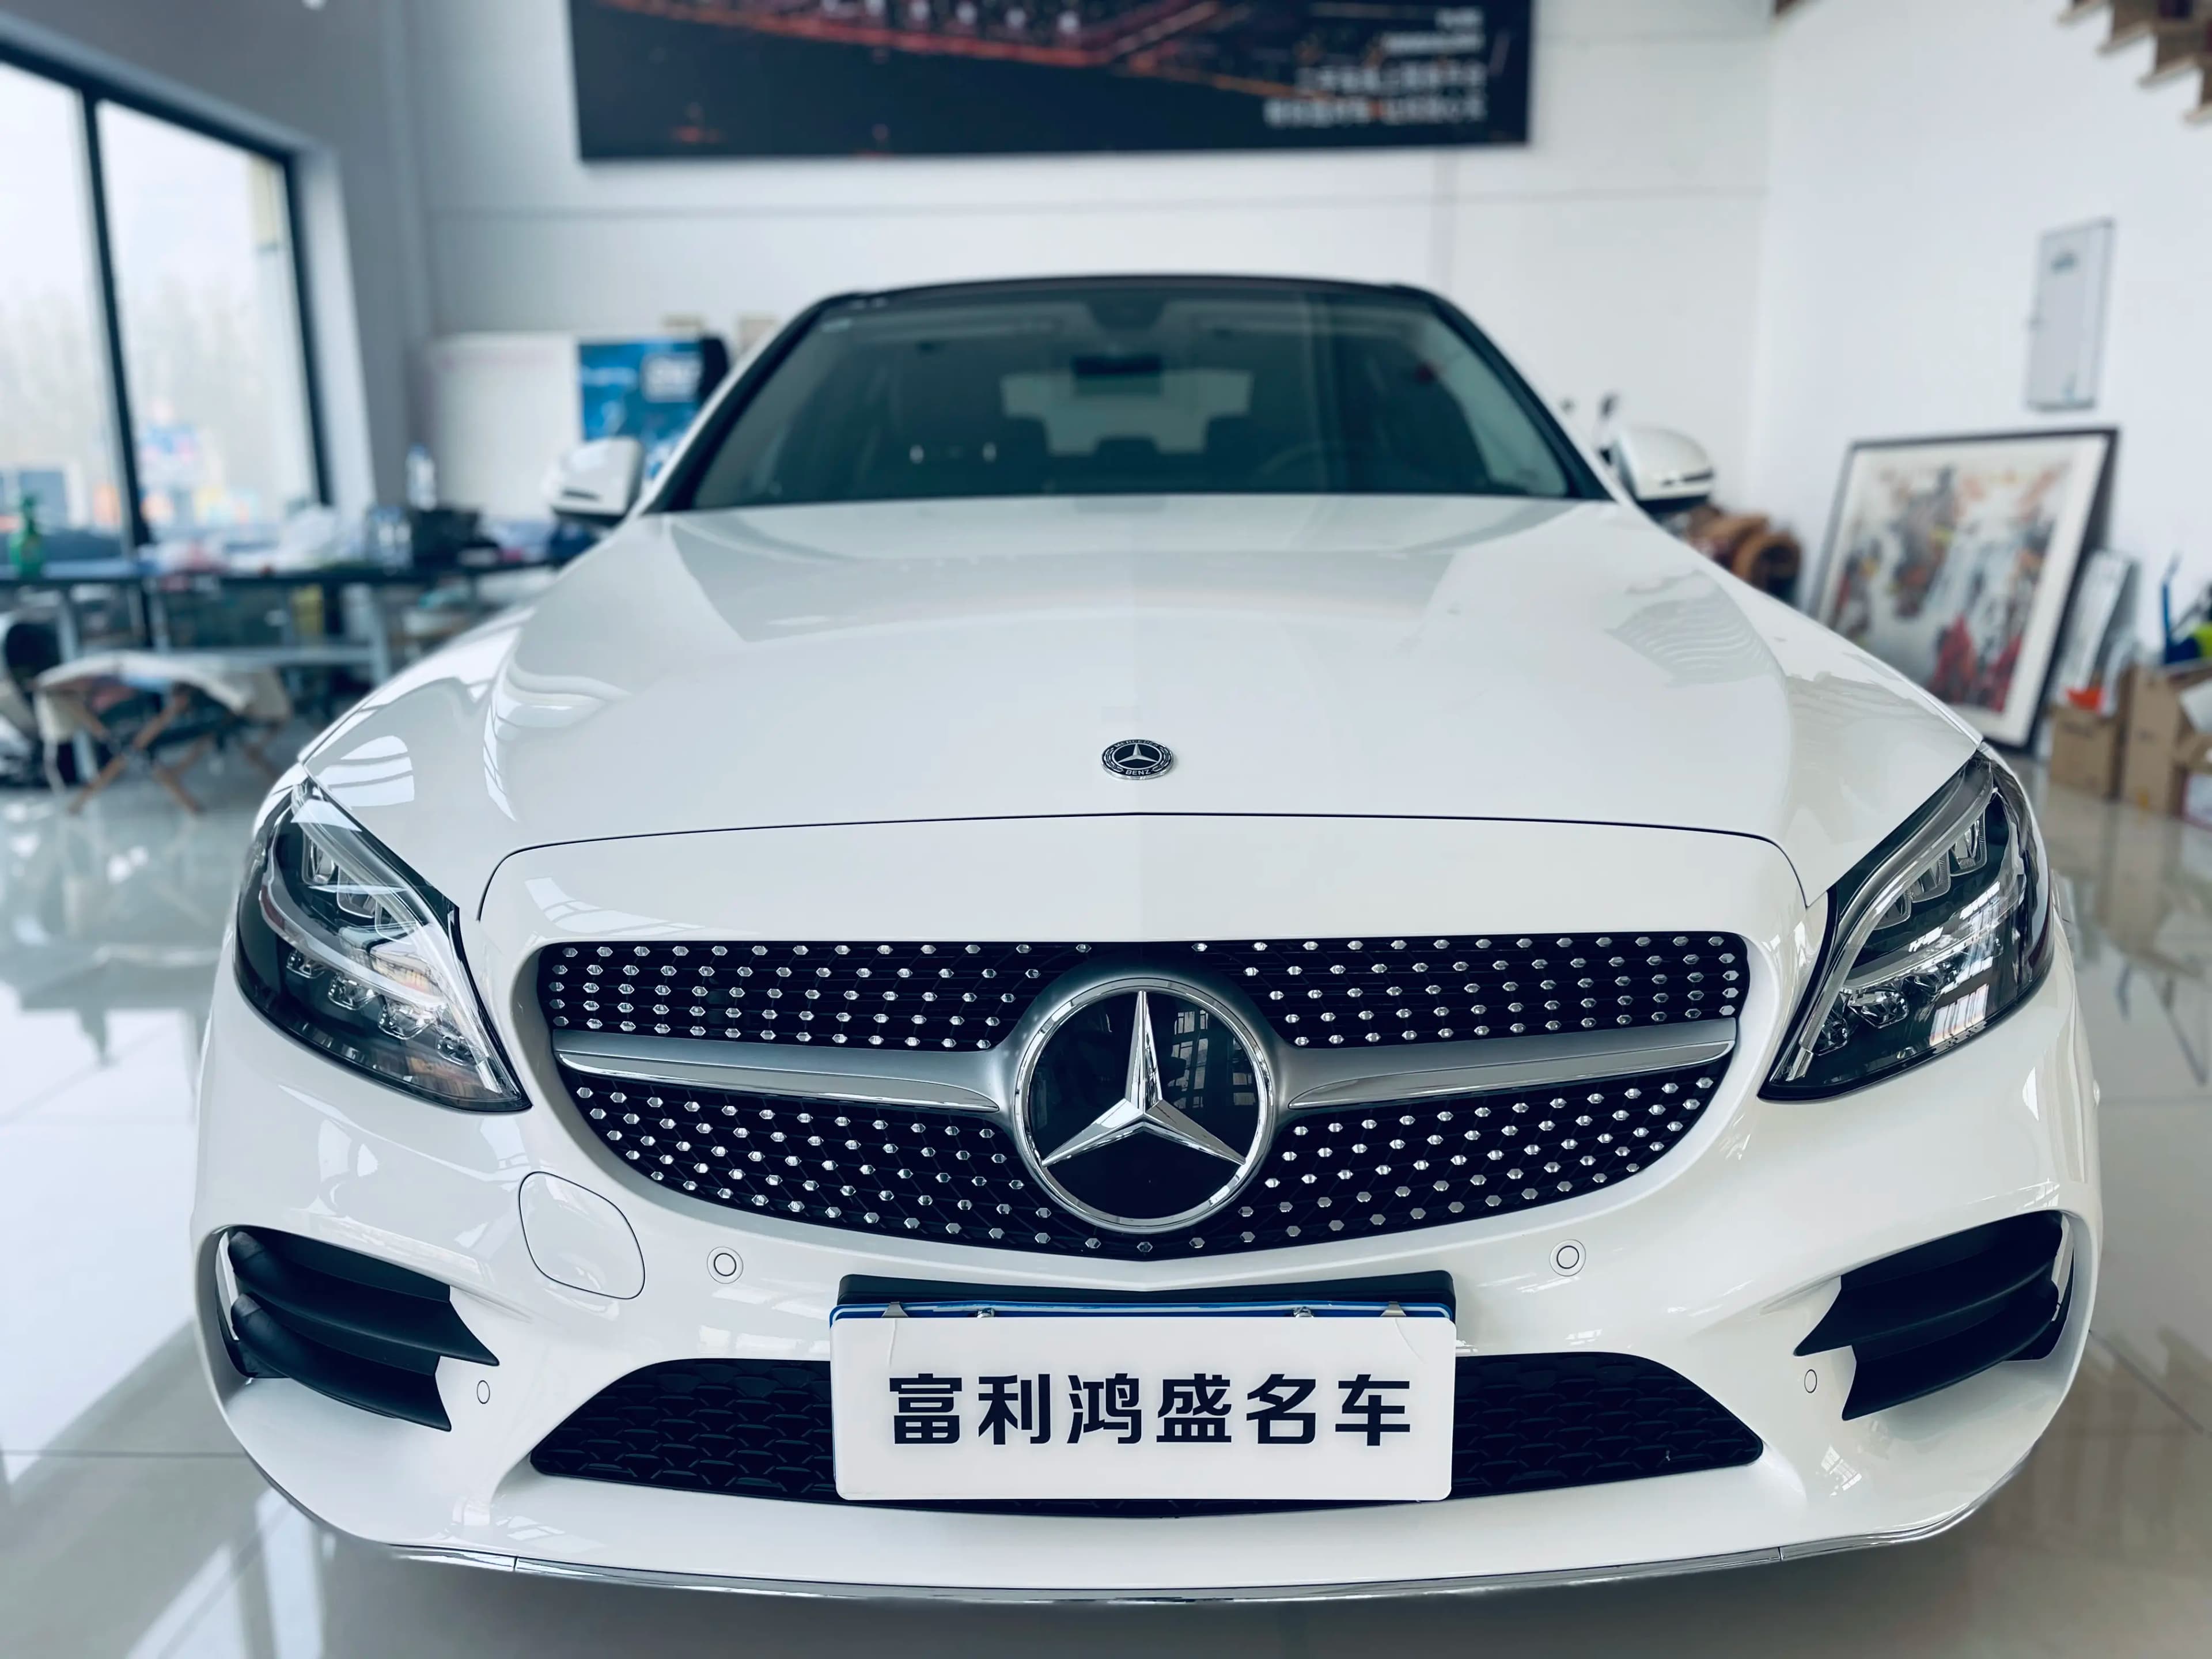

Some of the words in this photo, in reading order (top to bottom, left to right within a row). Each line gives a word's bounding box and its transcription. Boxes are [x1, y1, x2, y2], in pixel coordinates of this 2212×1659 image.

[889, 1373, 1411, 1446] 富利鸿盛名车
